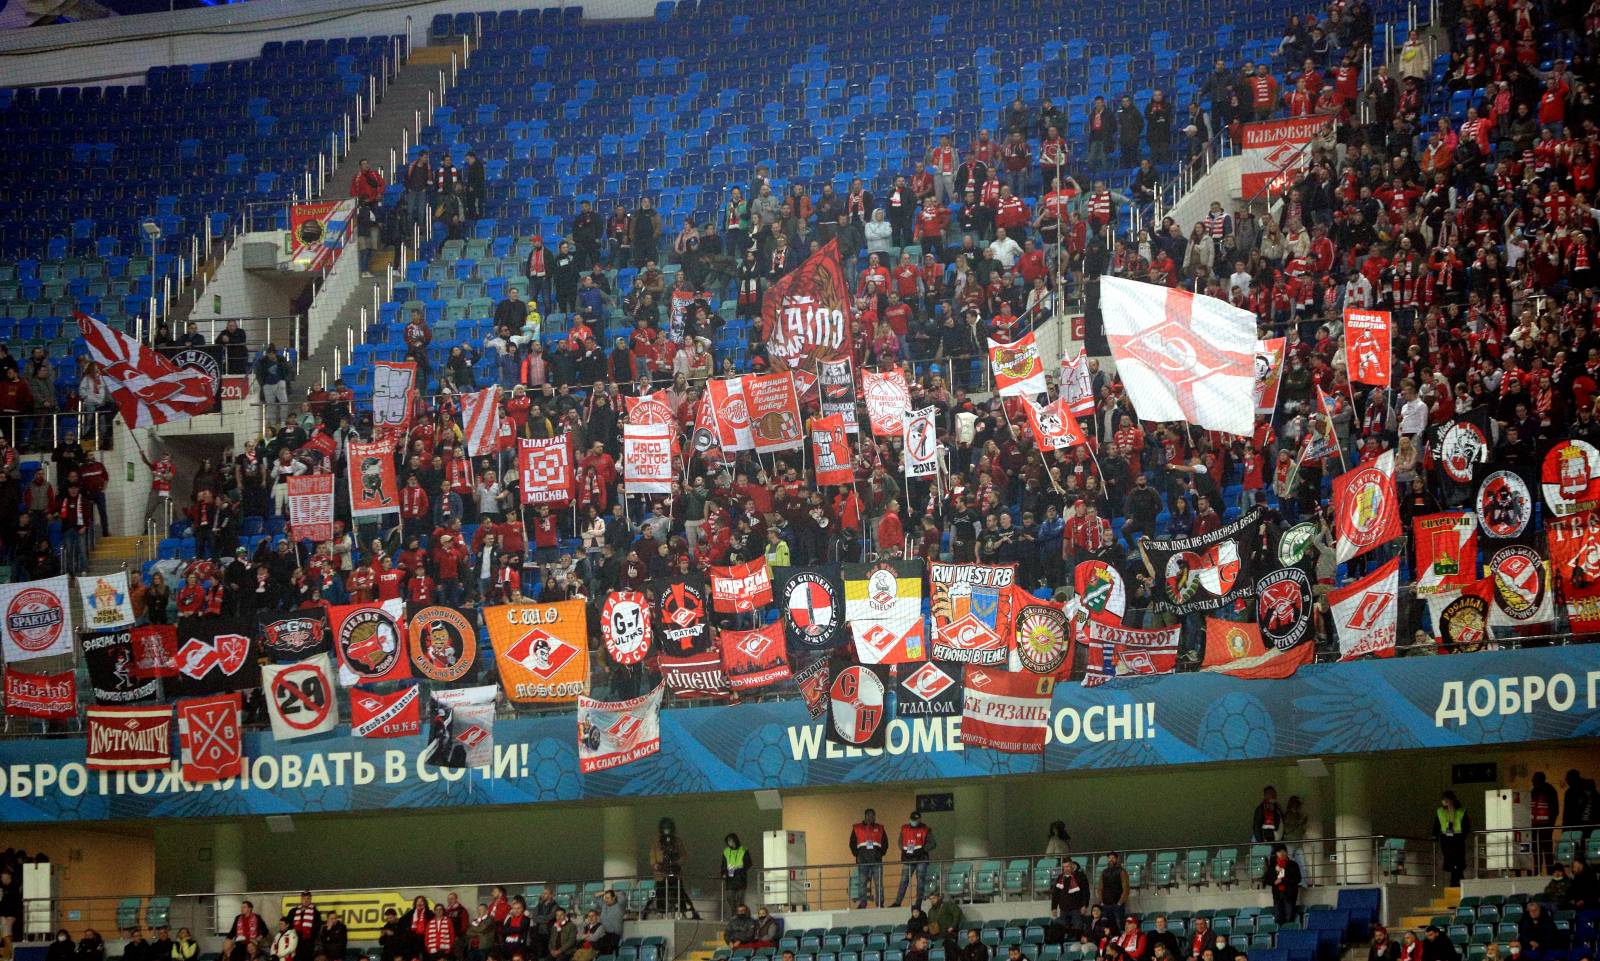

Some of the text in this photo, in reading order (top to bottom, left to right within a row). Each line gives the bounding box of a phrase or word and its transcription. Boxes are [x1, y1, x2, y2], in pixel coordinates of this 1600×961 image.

[1247, 121, 1328, 143] ПАВЛОВСКИ
[522, 433, 567, 448] СПАРТАК
[635, 464, 662, 475] 100%
[913, 462, 937, 473] ZONE
[527, 490, 569, 502] МОСКВА
[932, 565, 1012, 586] RW WEST RB
[785, 580, 796, 598] OLD
[797, 574, 834, 595] GUNNERS
[12, 609, 60, 628] SPARTAK
[613, 607, 640, 635] G-7
[341, 613, 379, 645] FRIENDS
[1095, 624, 1175, 645] ТАГАНРОГ
[277, 676, 326, 715] 29
[515, 681, 585, 699] MOSCOW
[1435, 673, 1576, 727] ДОБРО
[900, 700, 956, 715] ТАЛДОМ
[985, 702, 1047, 721] РЯЗАНЬ
[385, 749, 407, 784] В
[596, 753, 632, 769] СПАРТАК
